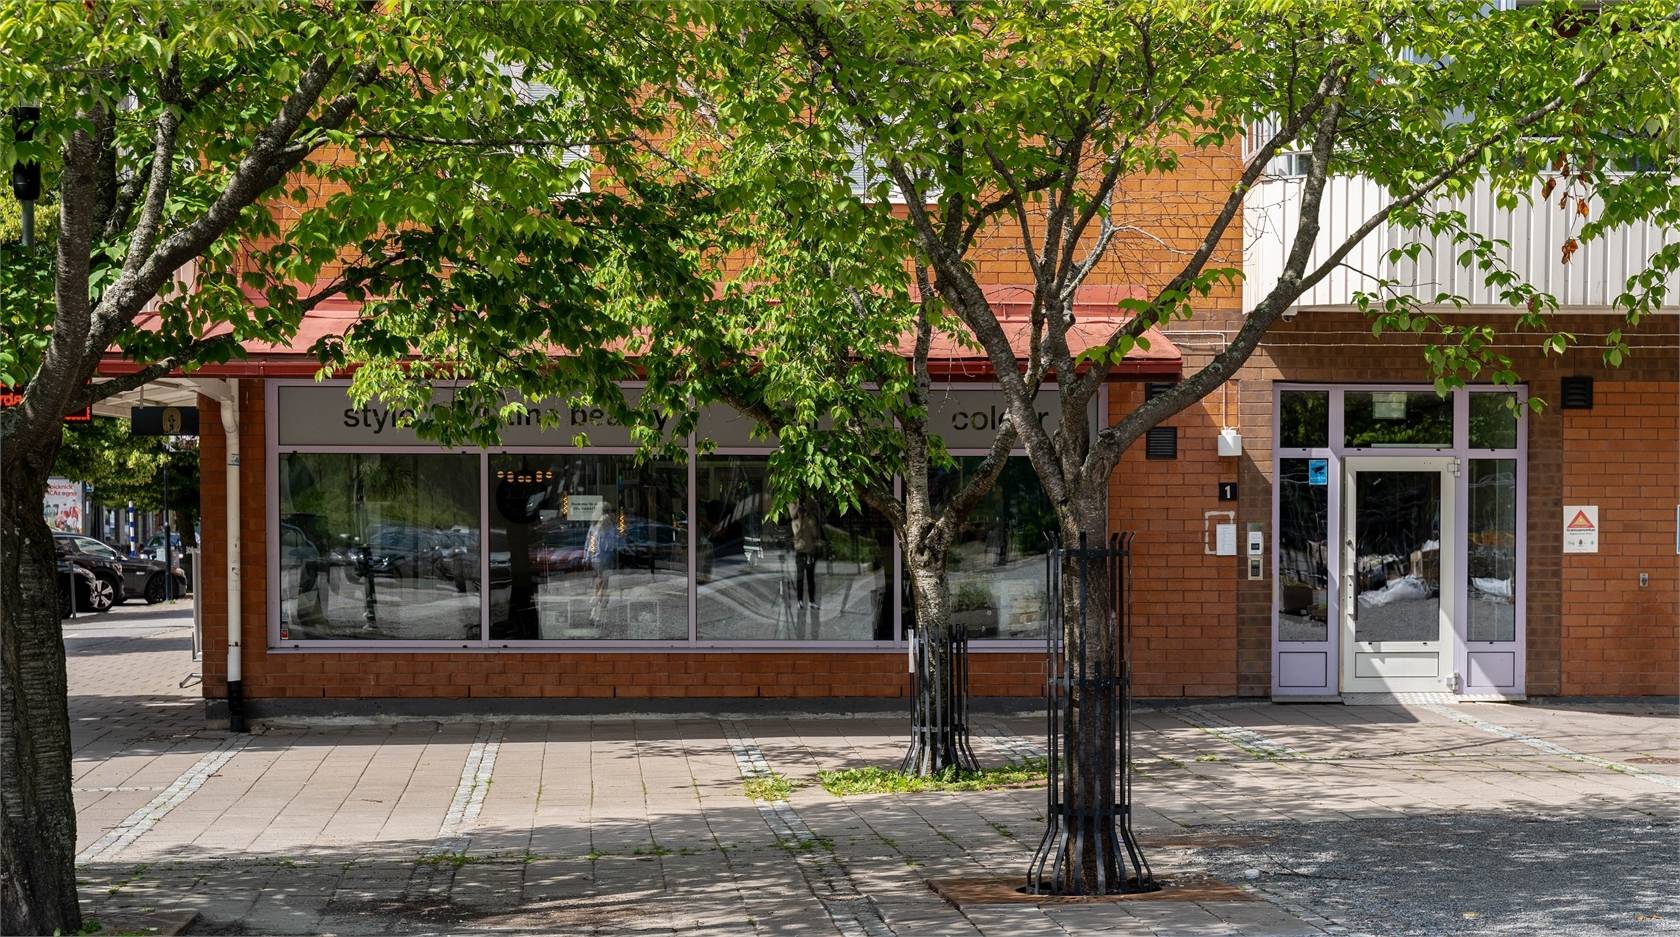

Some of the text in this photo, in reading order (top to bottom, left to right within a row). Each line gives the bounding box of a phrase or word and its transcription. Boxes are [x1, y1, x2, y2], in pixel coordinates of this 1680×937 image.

[571, 401, 669, 432] beay
[952, 405, 1048, 430] colr
[1224, 485, 1231, 499] 1
